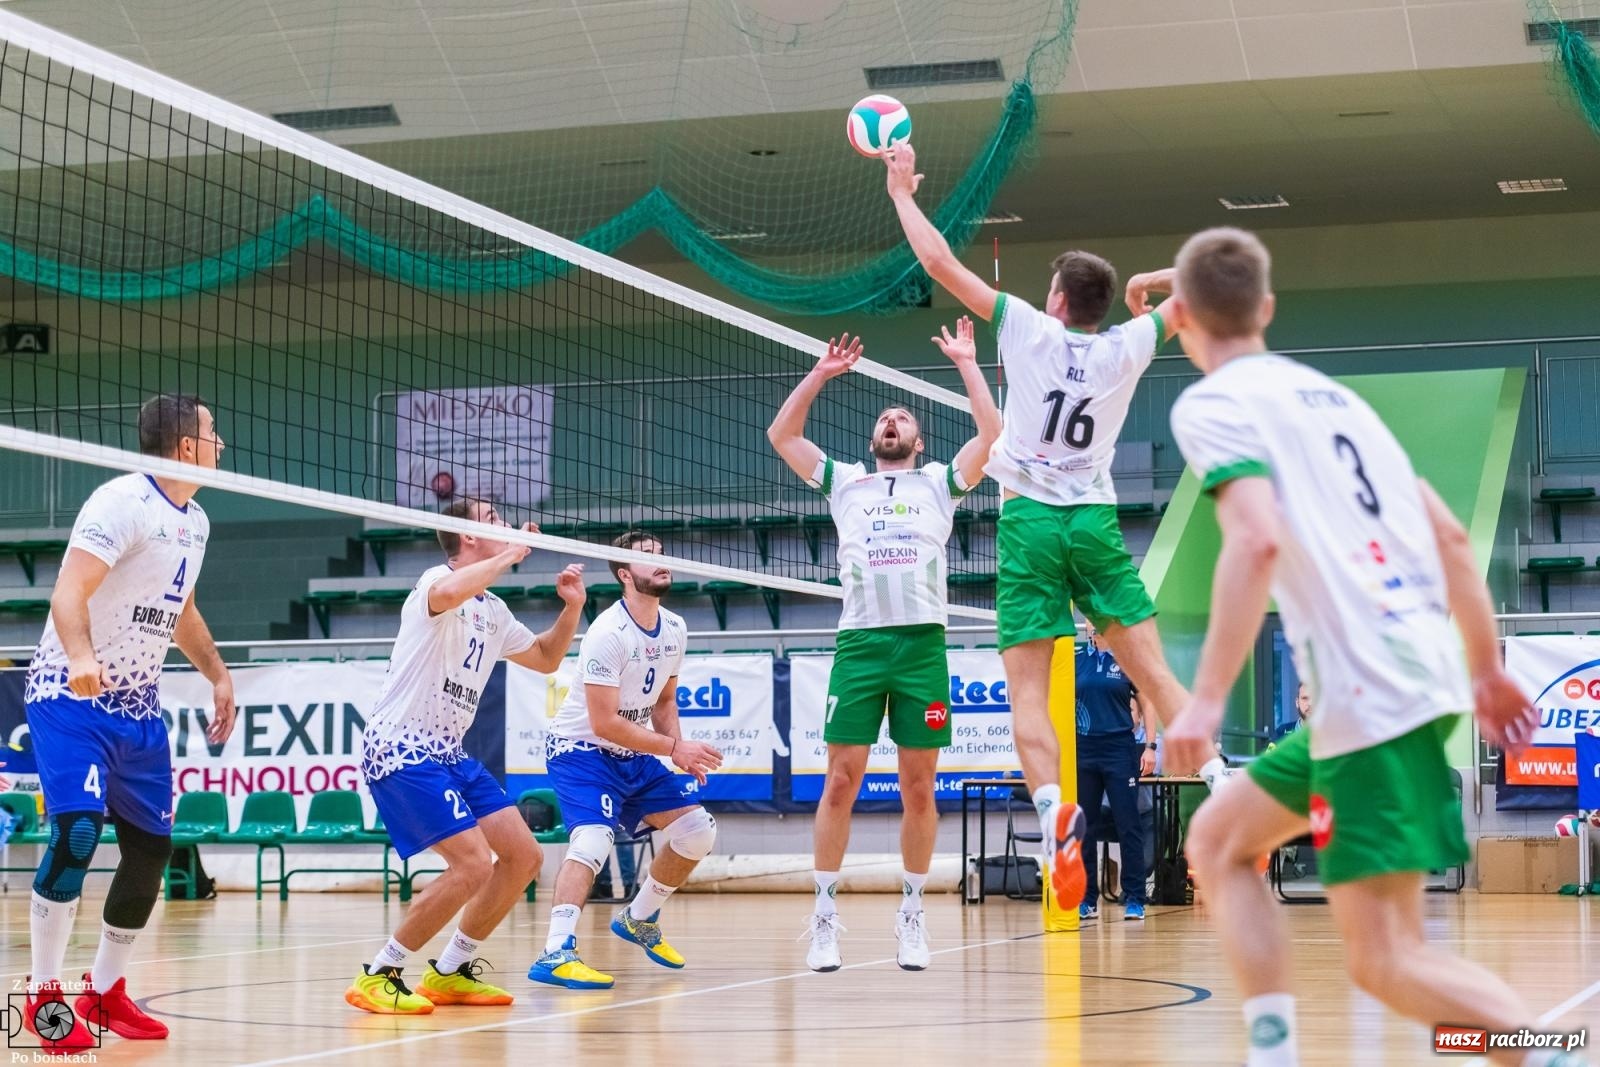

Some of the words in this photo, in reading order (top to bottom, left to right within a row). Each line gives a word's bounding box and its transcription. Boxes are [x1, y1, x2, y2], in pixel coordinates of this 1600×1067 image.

[413, 394, 533, 421] MIESZKO
[1041, 389, 1095, 451] 16
[884, 476, 896, 496] 7
[1334, 433, 1380, 518] 3
[868, 547, 918, 560] PIVEXIN
[869, 558, 918, 567] TECHNOLOGY
[172, 557, 187, 593] 4
[463, 637, 485, 672] 21
[643, 667, 656, 694] 9
[951, 676, 1010, 704] tec
[827, 696, 839, 724] 7
[715, 729, 735, 740] 363
[987, 726, 1010, 736] 606
[745, 746, 751, 756] 2
[966, 742, 1017, 754] Eichend
[84, 764, 101, 798] 4
[444, 789, 471, 820] 2
[601, 794, 613, 818] 9
